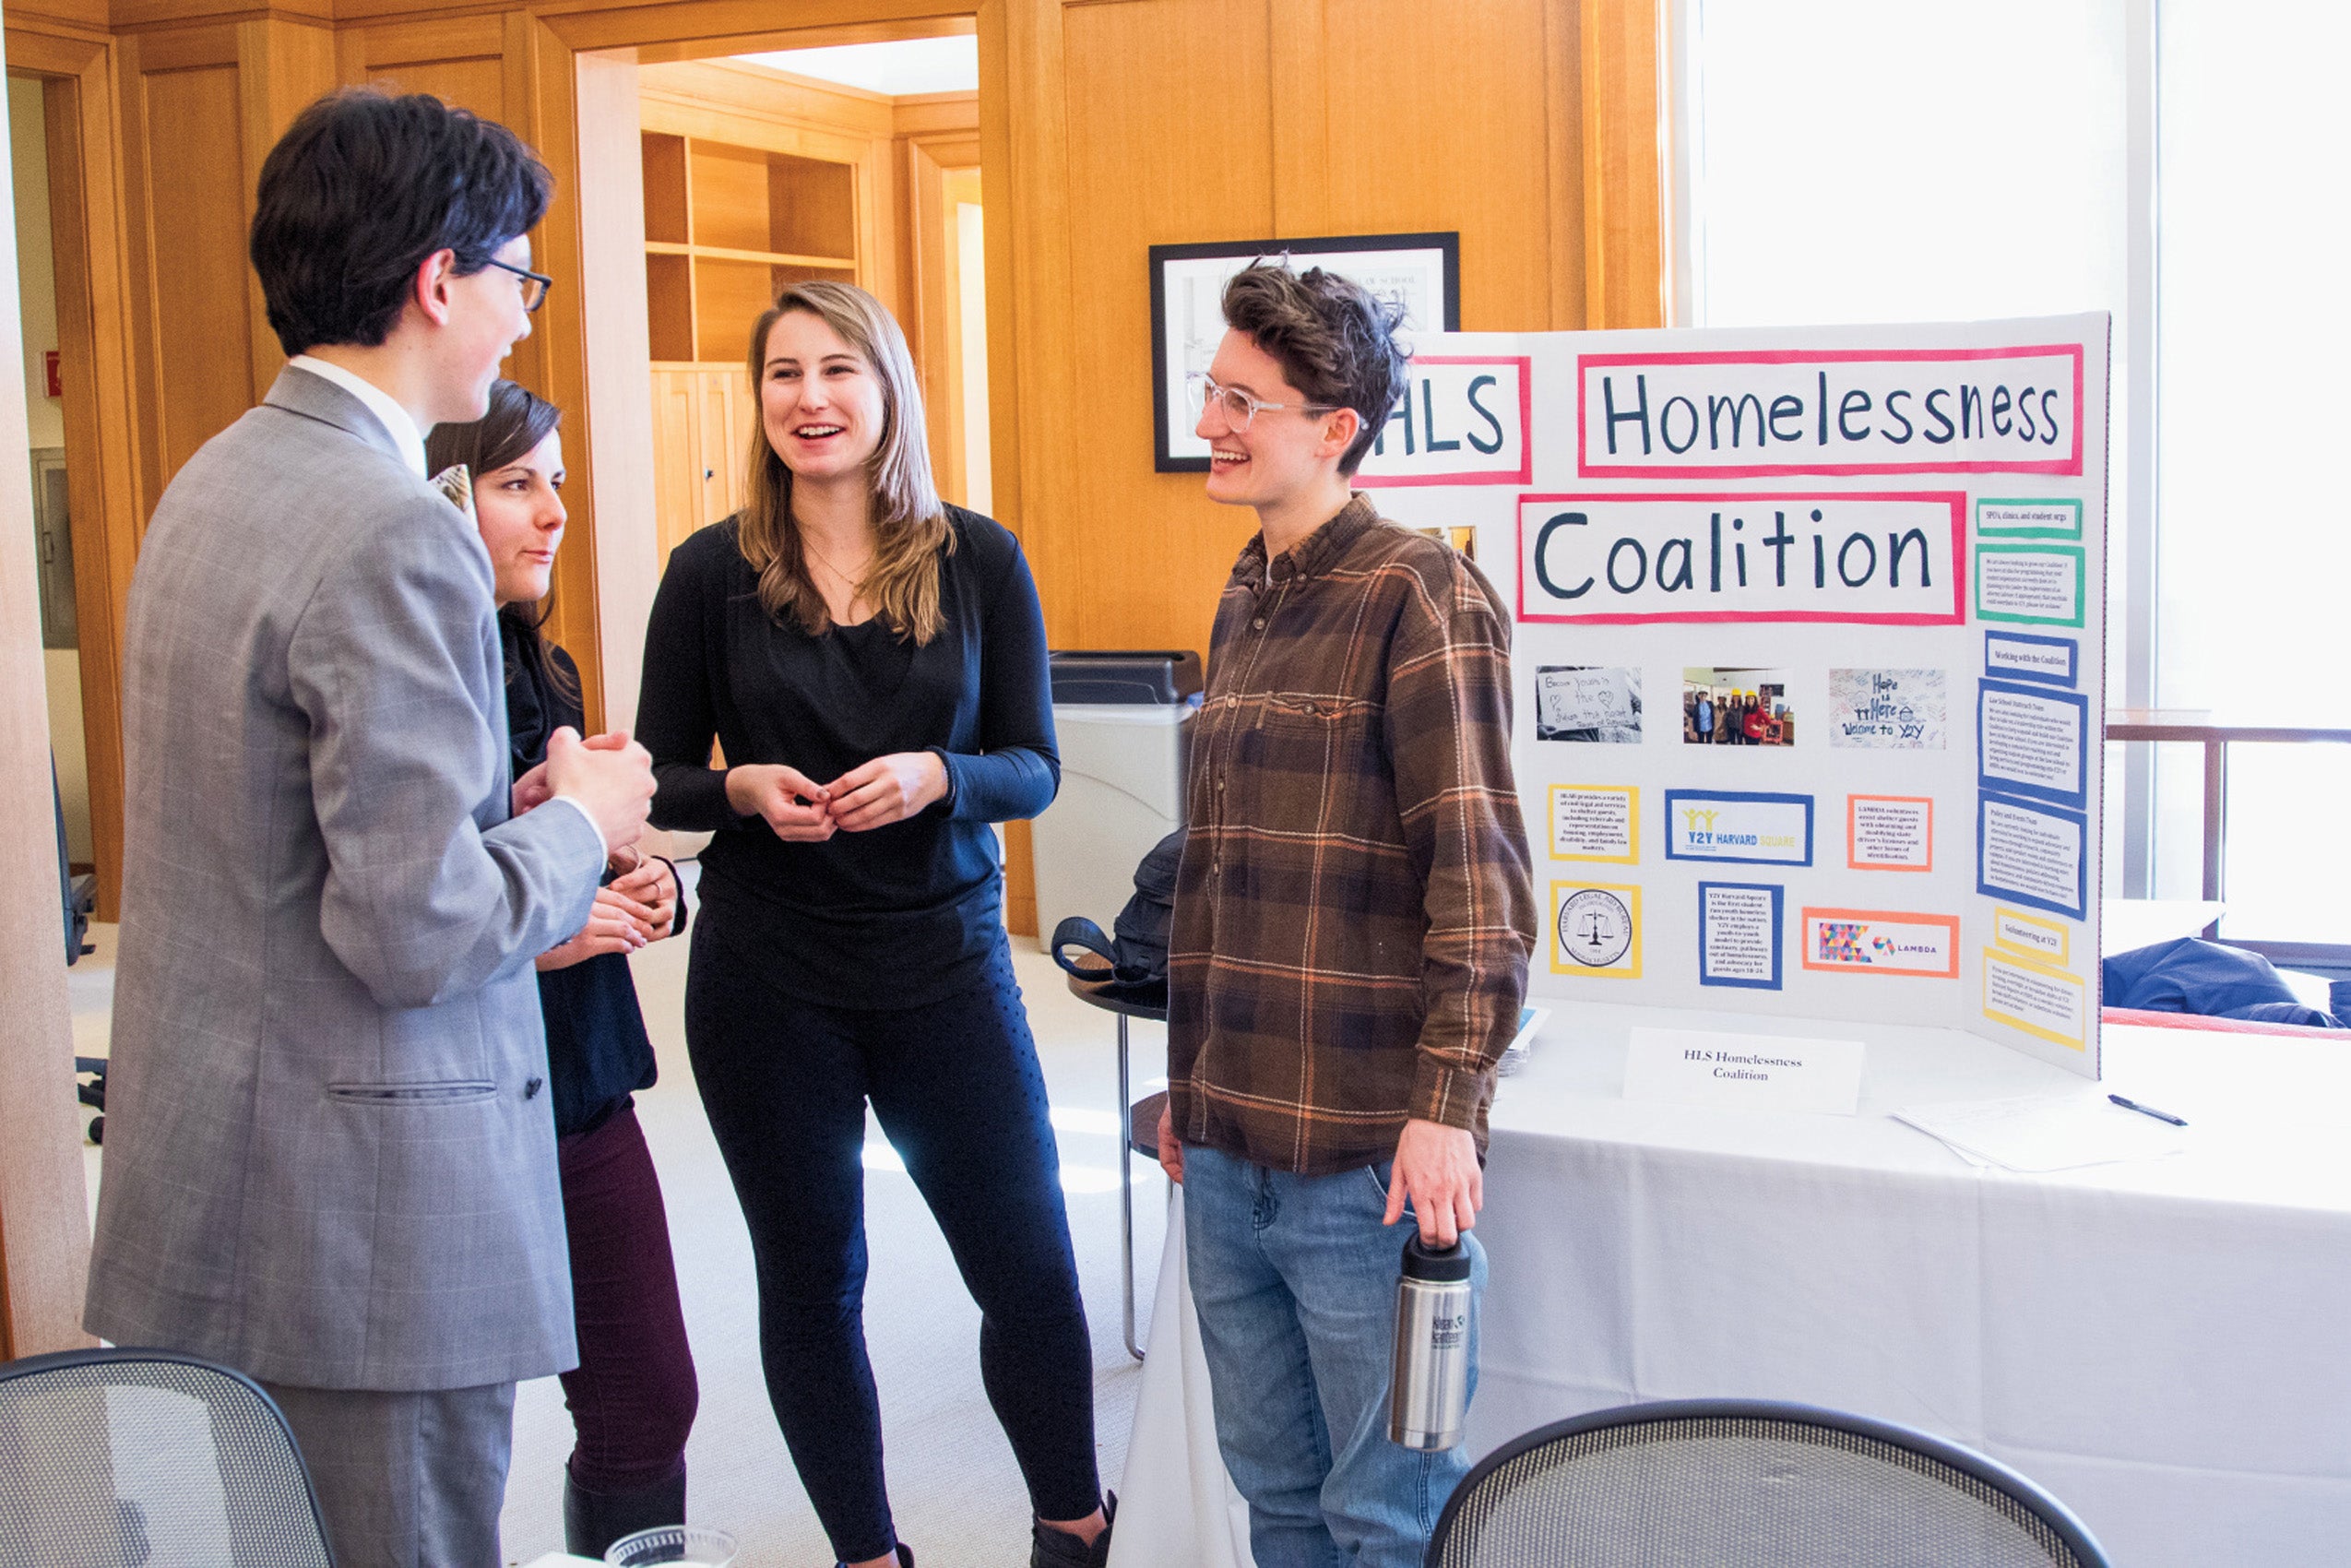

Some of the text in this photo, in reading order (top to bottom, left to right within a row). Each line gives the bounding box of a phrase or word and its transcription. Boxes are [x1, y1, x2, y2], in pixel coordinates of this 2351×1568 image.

[1374, 371, 2060, 457] HLS Homelessness
[1534, 508, 1932, 600] Coalition
[1995, 649, 2066, 665] Working with the Coalition
[1872, 672, 1898, 695] Hope
[1879, 724, 1894, 735] to
[1899, 724, 1924, 740] Y2Y
[1689, 831, 1796, 847] Y2Y HARVARD SQUARE
[1897, 944, 1937, 954] LAMBDA
[1684, 1050, 1803, 1067] HLS Homelessness
[1713, 1067, 1769, 1081] Coalition
